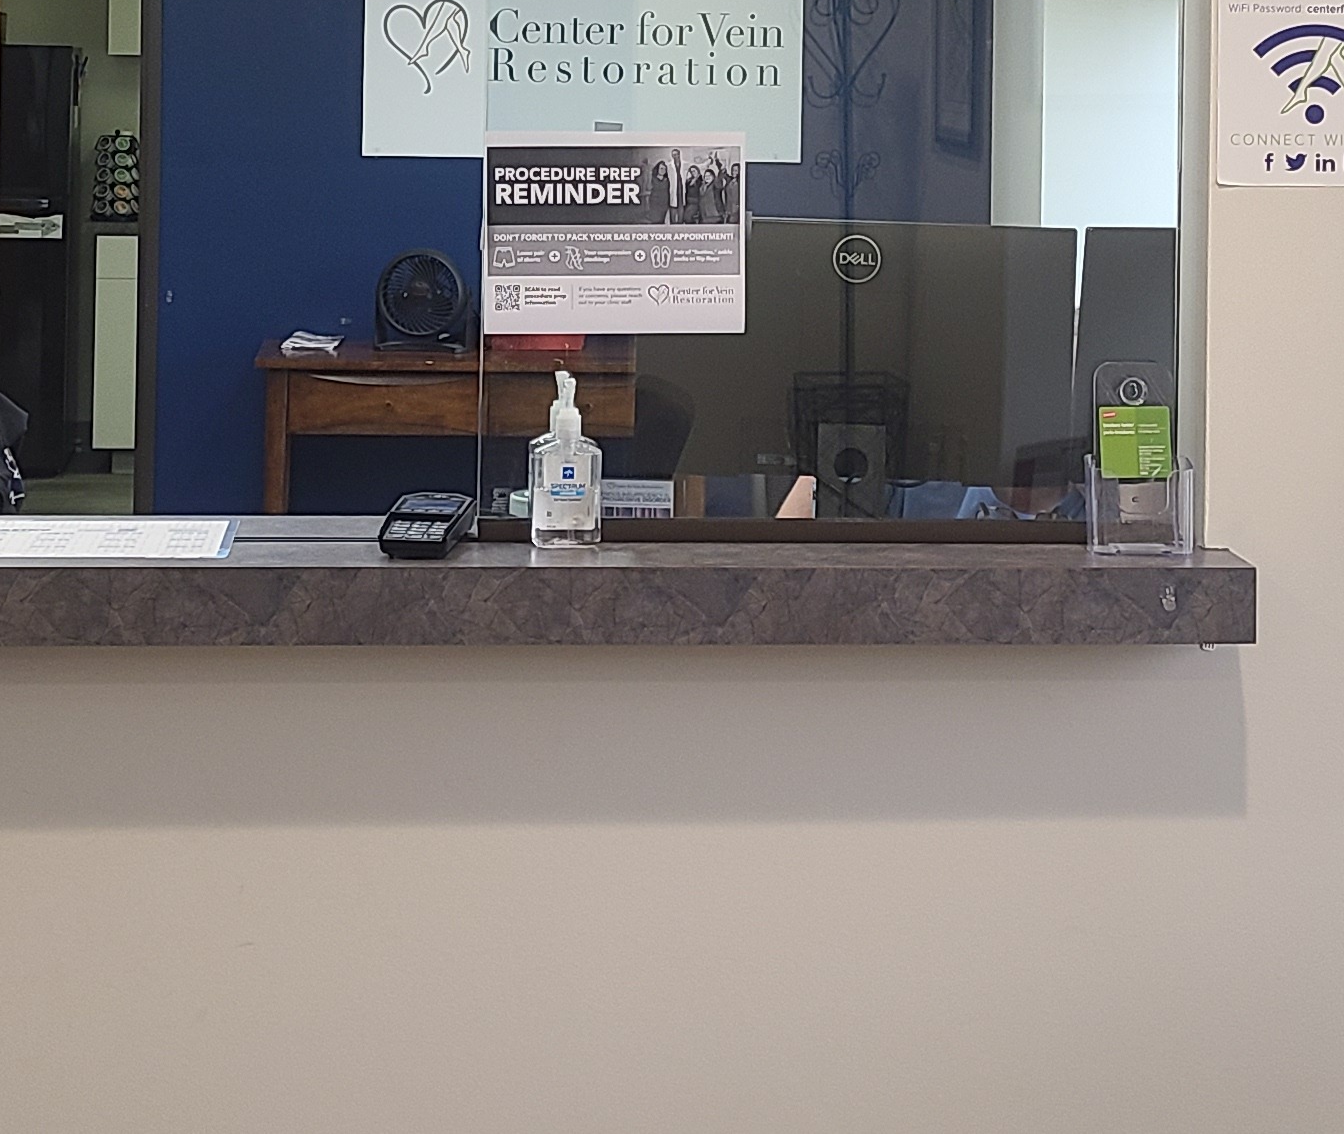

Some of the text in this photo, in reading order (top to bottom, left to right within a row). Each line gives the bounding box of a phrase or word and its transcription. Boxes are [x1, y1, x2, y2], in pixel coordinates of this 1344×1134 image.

[1229, 4, 1250, 13] WiFi
[489, 8, 784, 49] Center for Vein
[488, 47, 782, 87] Restoration
[1230, 134, 1315, 145] CONNECT
[494, 167, 641, 182] PROCEDURE PREP
[495, 183, 641, 205] REMINDER
[839, 252, 875, 266] DELL
